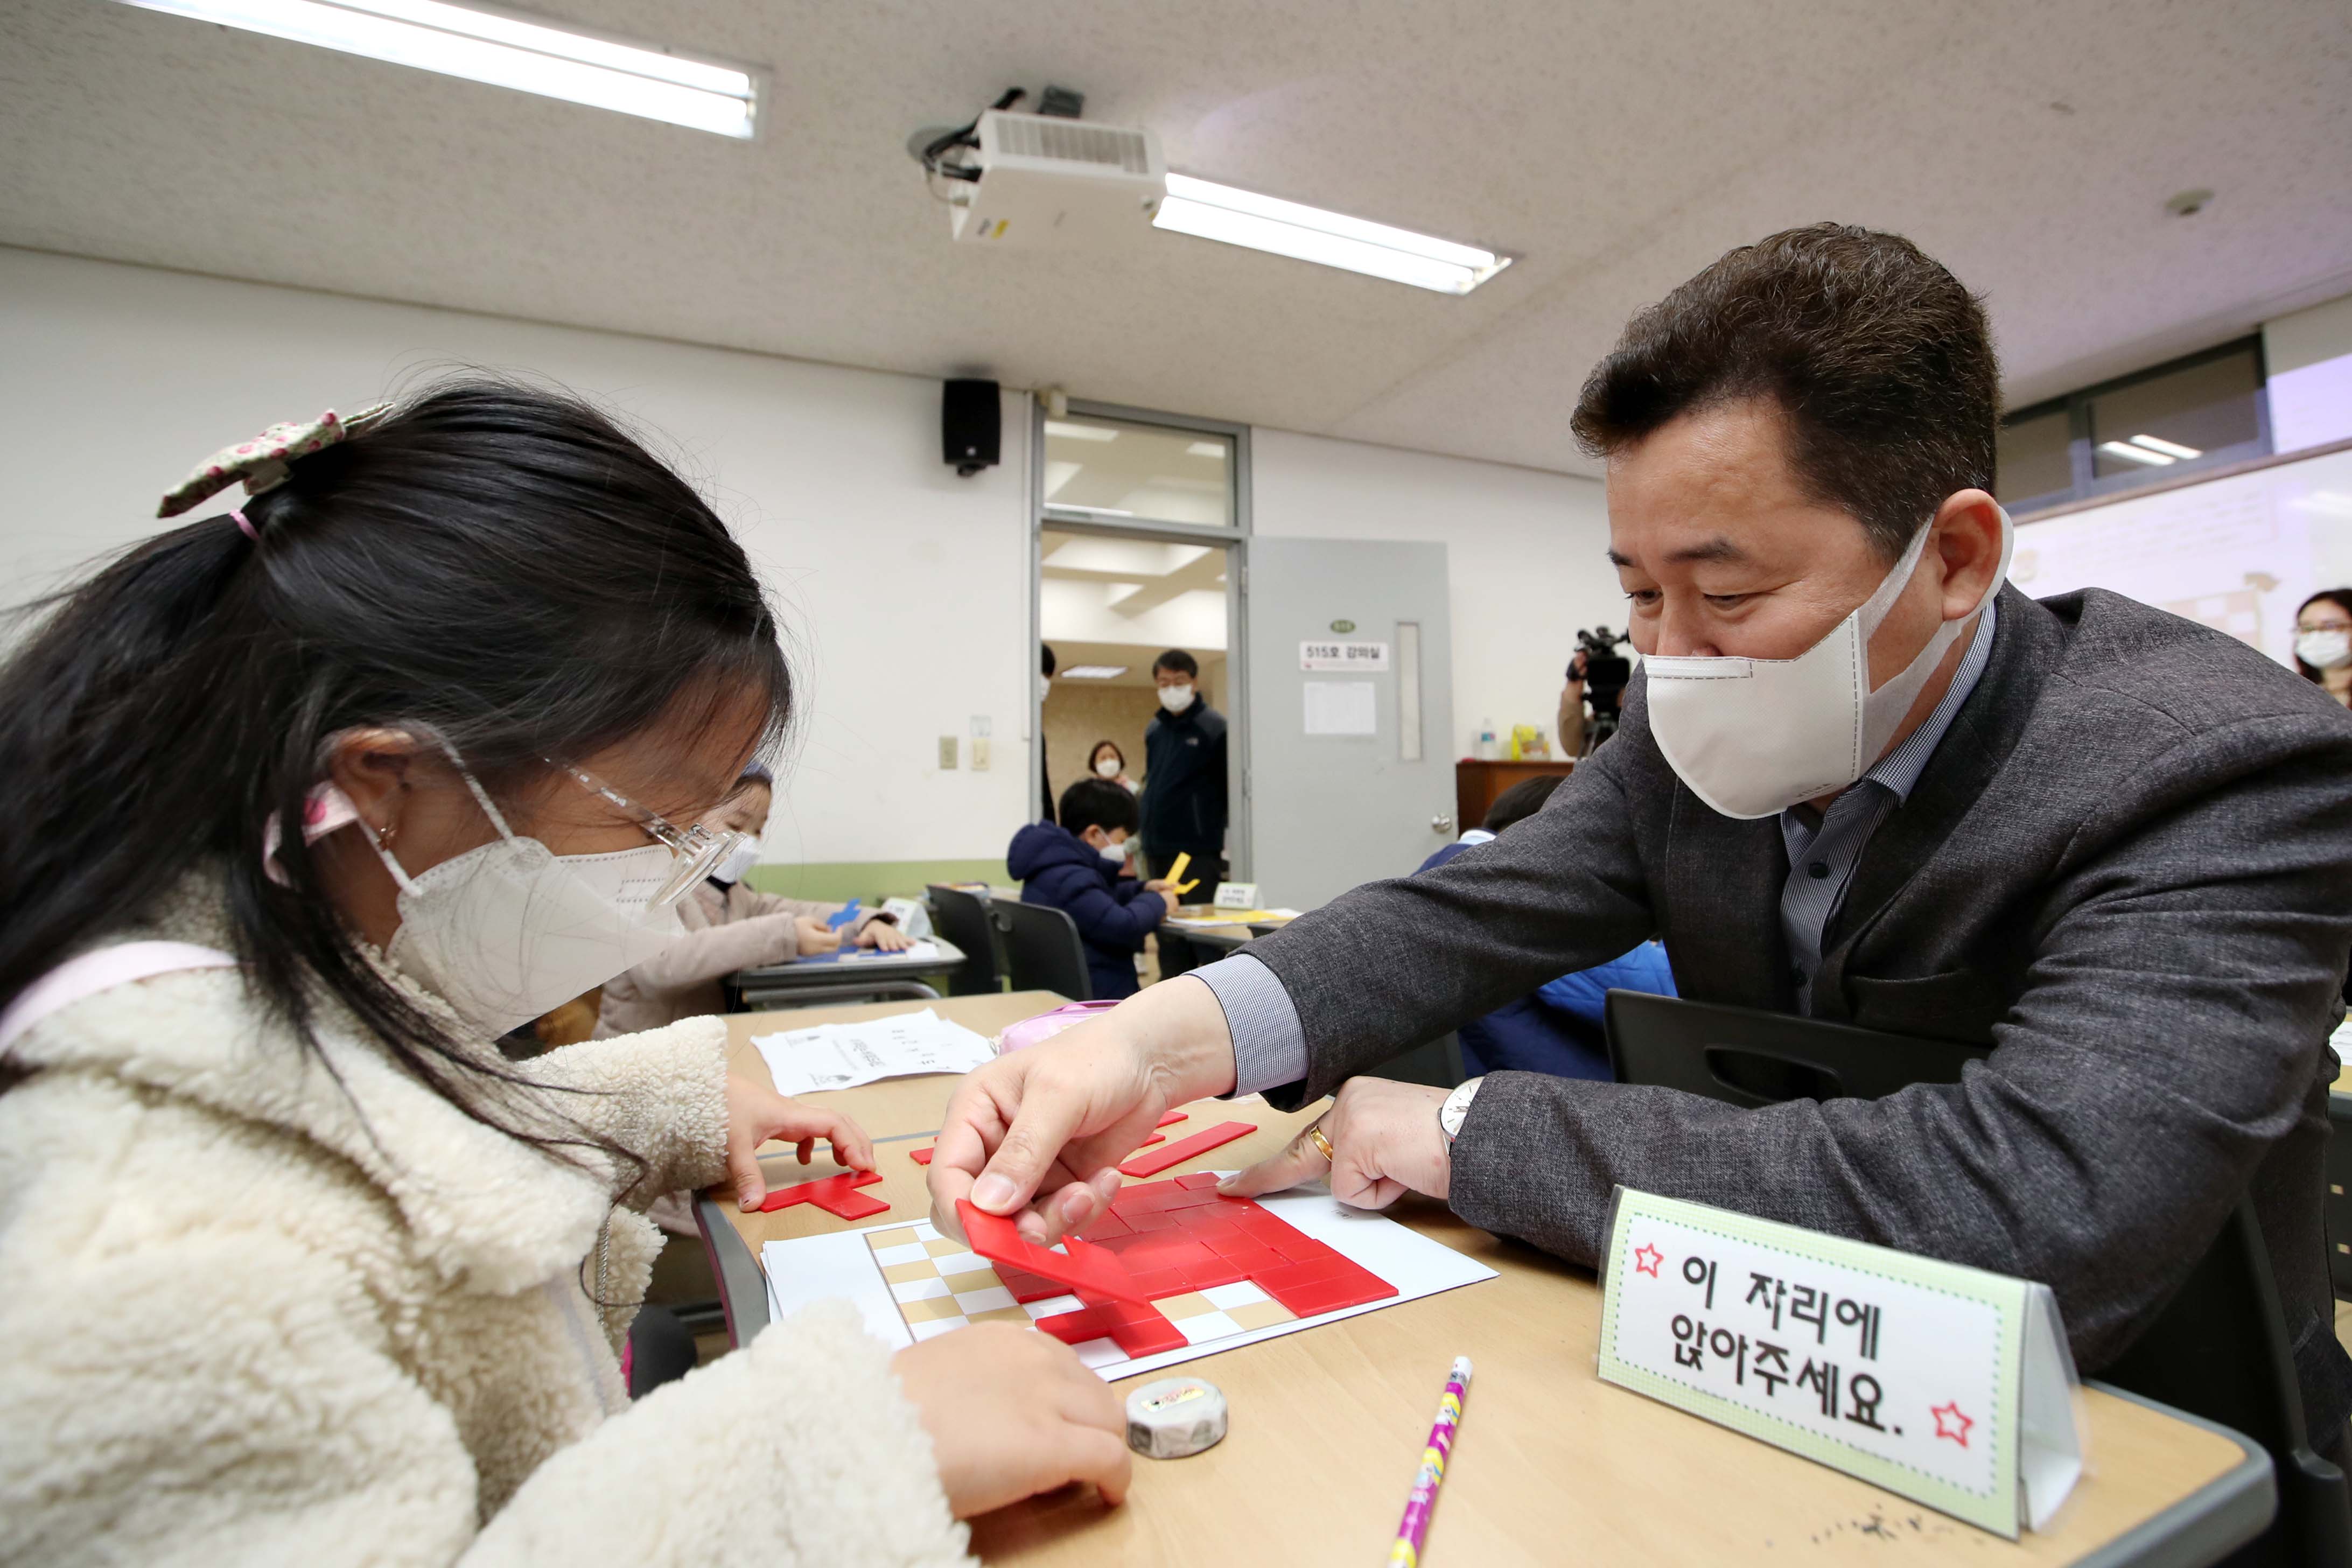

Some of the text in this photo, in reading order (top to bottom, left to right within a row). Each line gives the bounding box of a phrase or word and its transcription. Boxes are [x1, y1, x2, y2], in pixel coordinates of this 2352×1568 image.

[1307, 646, 1380, 659] 515호 강의실
[1683, 1256, 1880, 1361] 이 자리에
[1671, 1314, 1903, 1436] 앉아주세요.
